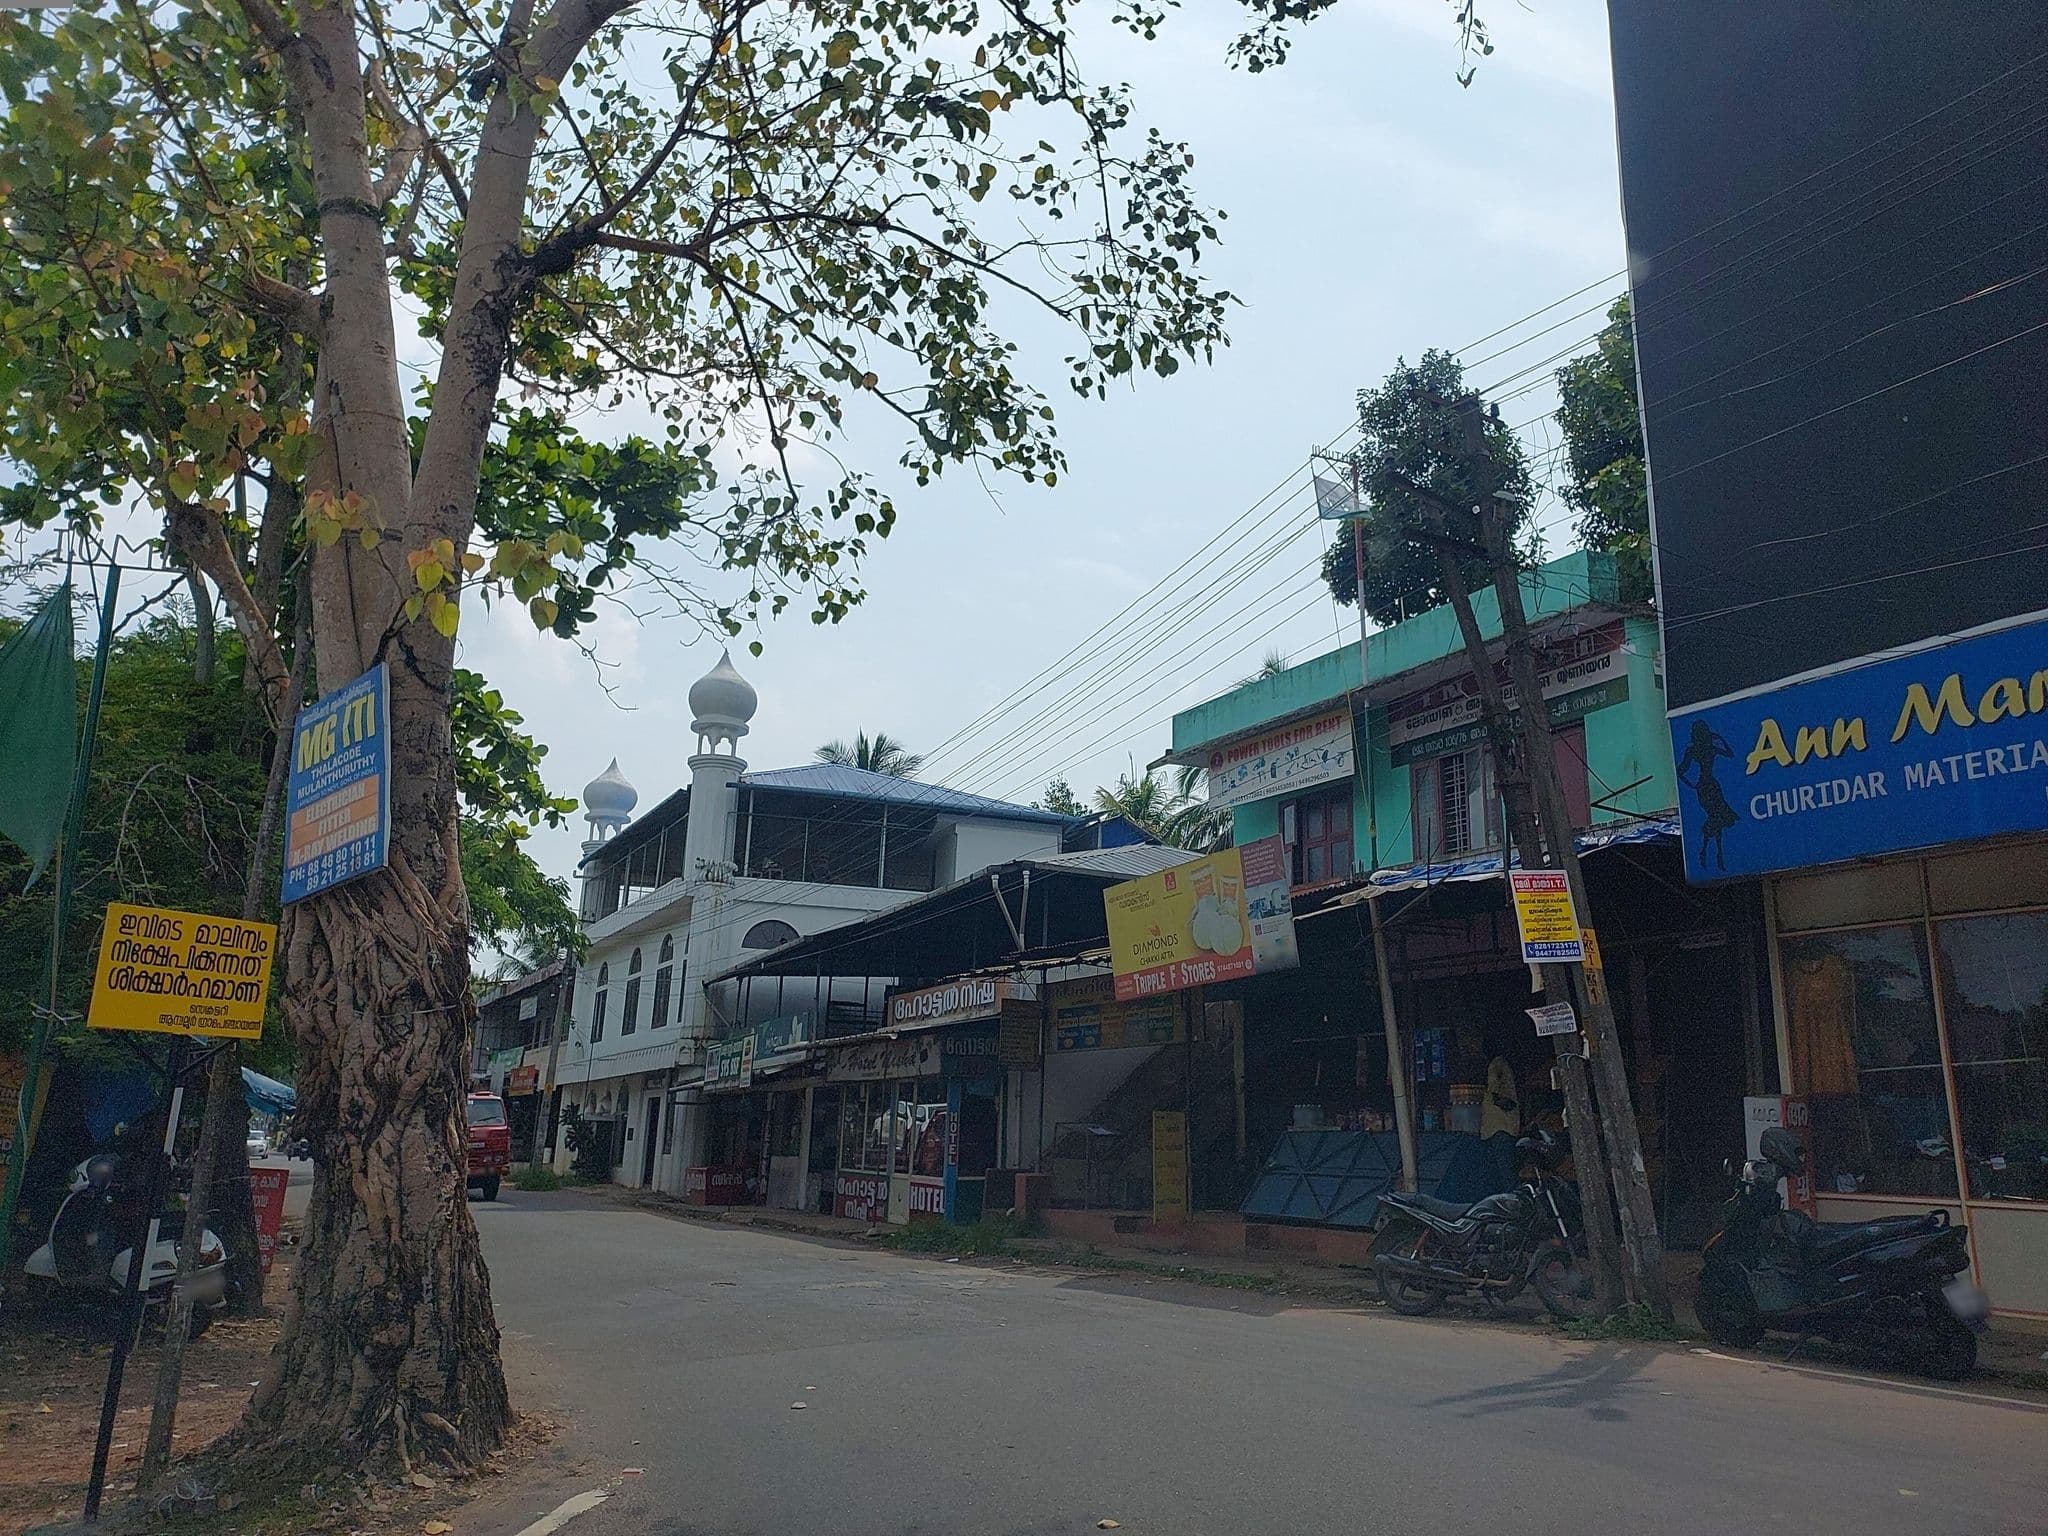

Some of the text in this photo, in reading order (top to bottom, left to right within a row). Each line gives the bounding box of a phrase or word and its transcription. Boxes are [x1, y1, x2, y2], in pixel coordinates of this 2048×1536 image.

[297, 713, 338, 774] MG
[342, 692, 376, 748] ITI
[1227, 715, 1343, 764] POWER TOOLS FOR RENT
[1744, 717, 1867, 776] Ann
[297, 752, 376, 799] MULANTHURUTHY
[311, 746, 361, 780] THALACODE
[1748, 771, 1889, 821] CHURIDAR
[289, 834, 376, 884] PH: 88 48 80 10 11
[306, 875, 319, 892] 89
[321, 869, 333, 885] 21
[335, 862, 347, 878] 25
[363, 850, 375, 866] 81
[119, 913, 268, 954] ഇവിടെ മാലിന്യം
[1133, 933, 1179, 955] DIAMONDS
[111, 939, 268, 977] നിക്ഷേപിക്കുന്നത്
[1133, 972, 1166, 995] TRIPPLE
[1170, 966, 1177, 986] F
[1181, 960, 1217, 985] STORES
[1140, 950, 1175, 967] CHAKKI ATTA
[108, 965, 263, 1003] ശിക്ഷാർഹമാണ്
[895, 987, 959, 1019] ഹോട്ടൽ
[949, 1111, 957, 1165] HOTEL
[910, 1186, 945, 1214] HOTEL
